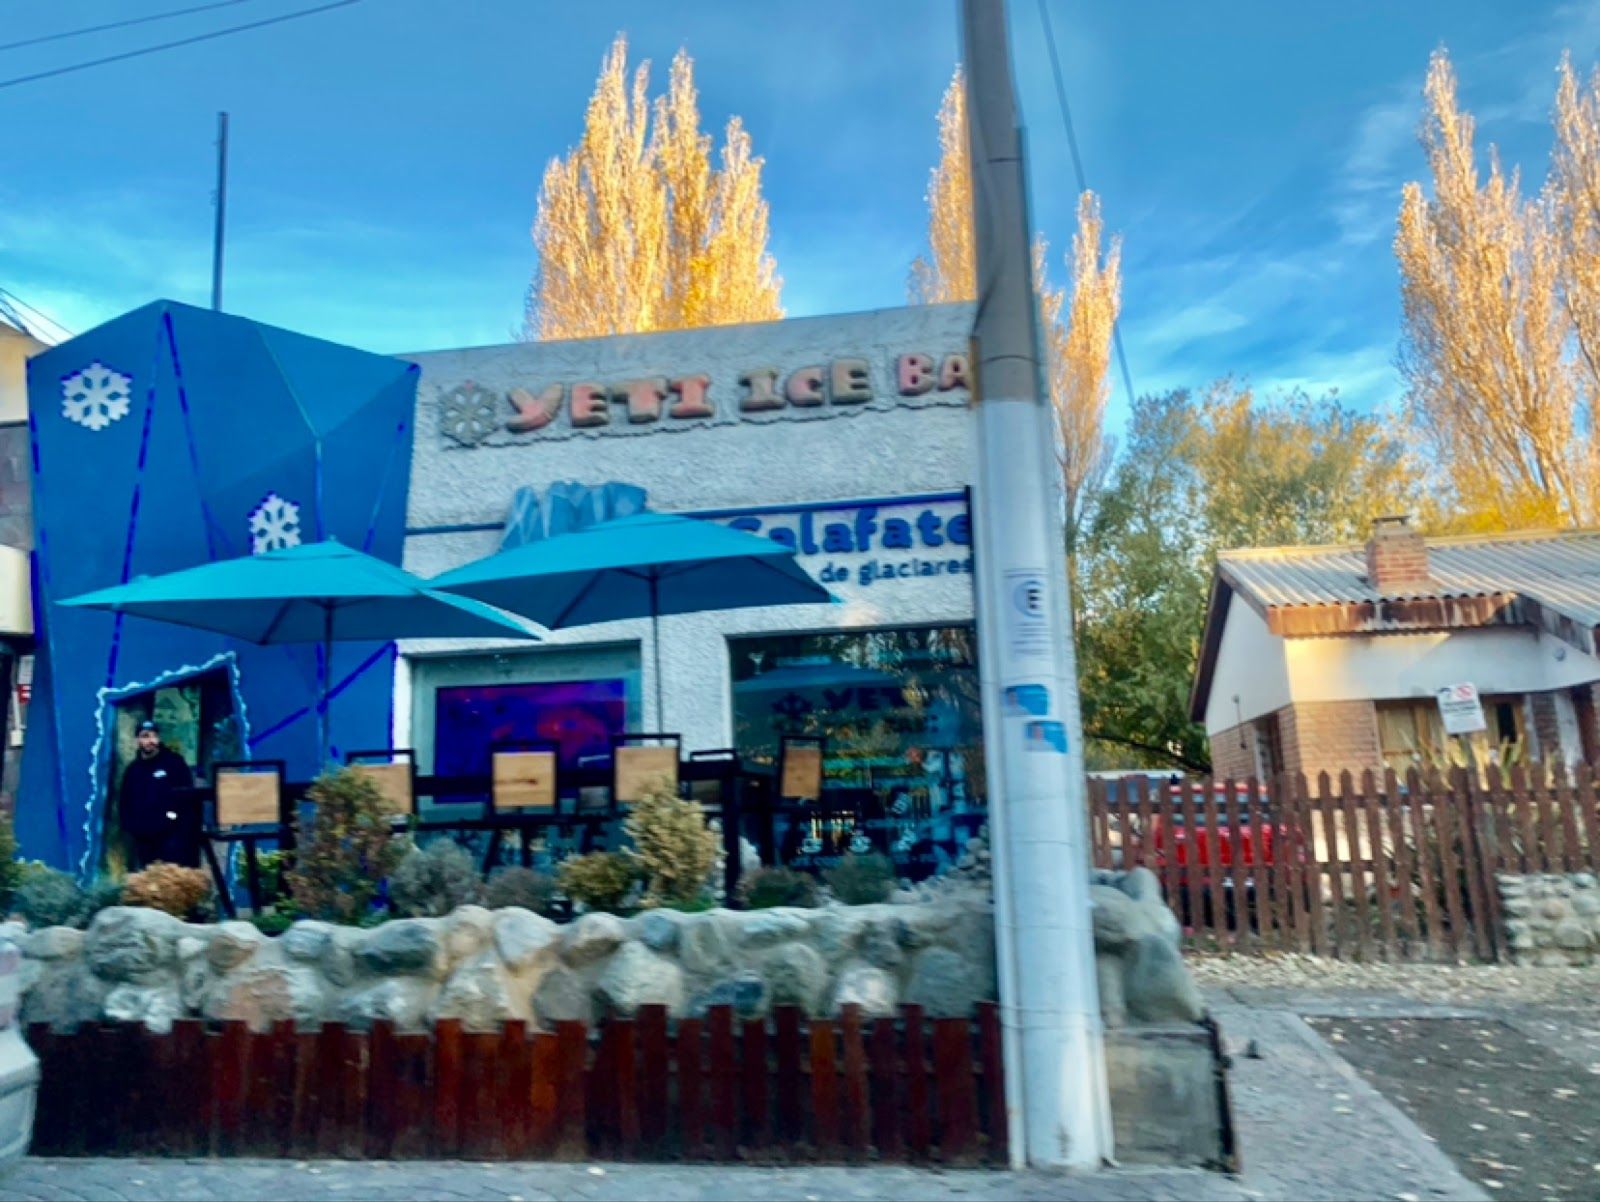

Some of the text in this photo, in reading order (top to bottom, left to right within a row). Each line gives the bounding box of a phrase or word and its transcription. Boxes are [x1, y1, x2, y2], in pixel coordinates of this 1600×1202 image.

[505, 375, 714, 433] YETI
[737, 357, 873, 410] ICE
[820, 561, 849, 583] de
